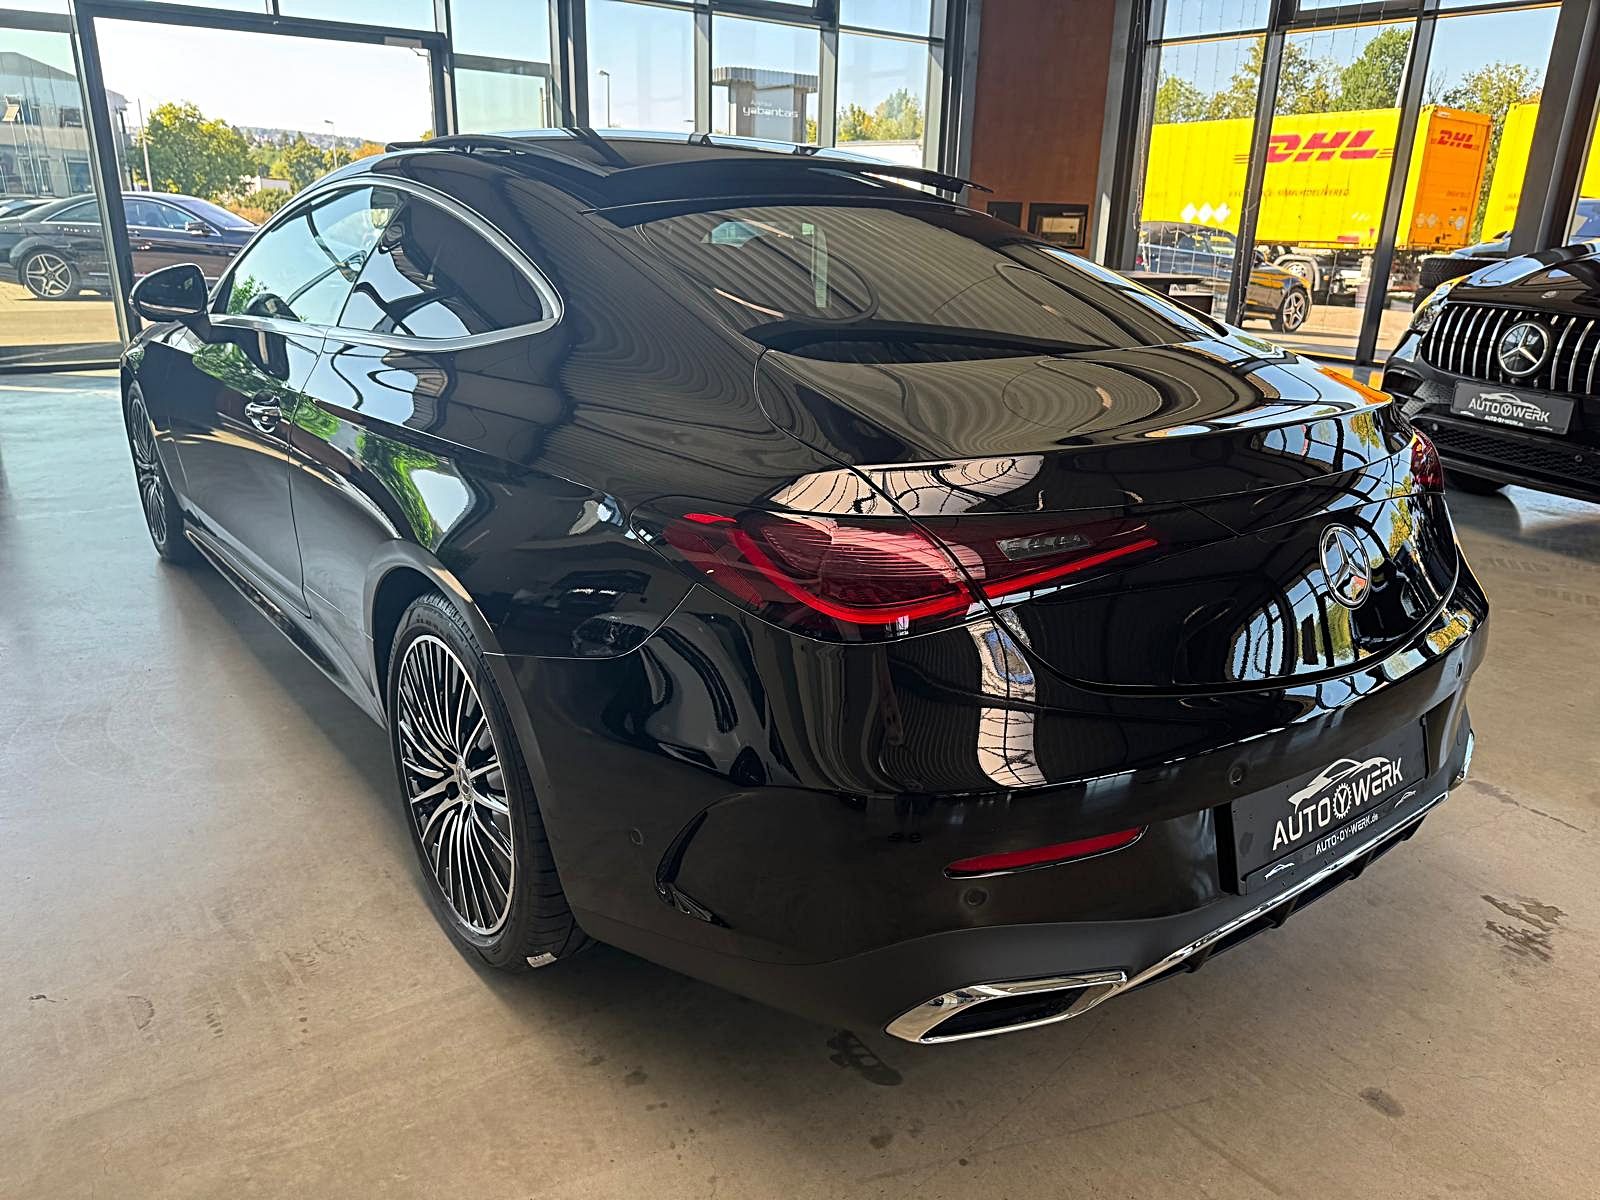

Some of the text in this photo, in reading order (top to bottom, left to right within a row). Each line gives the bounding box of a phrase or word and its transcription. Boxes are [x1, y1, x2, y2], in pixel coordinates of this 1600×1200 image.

[1267, 130, 1380, 163] DHL
[1437, 129, 1474, 150] DHL
[1315, 812, 1379, 855] AUTO-OY-WERK.de
